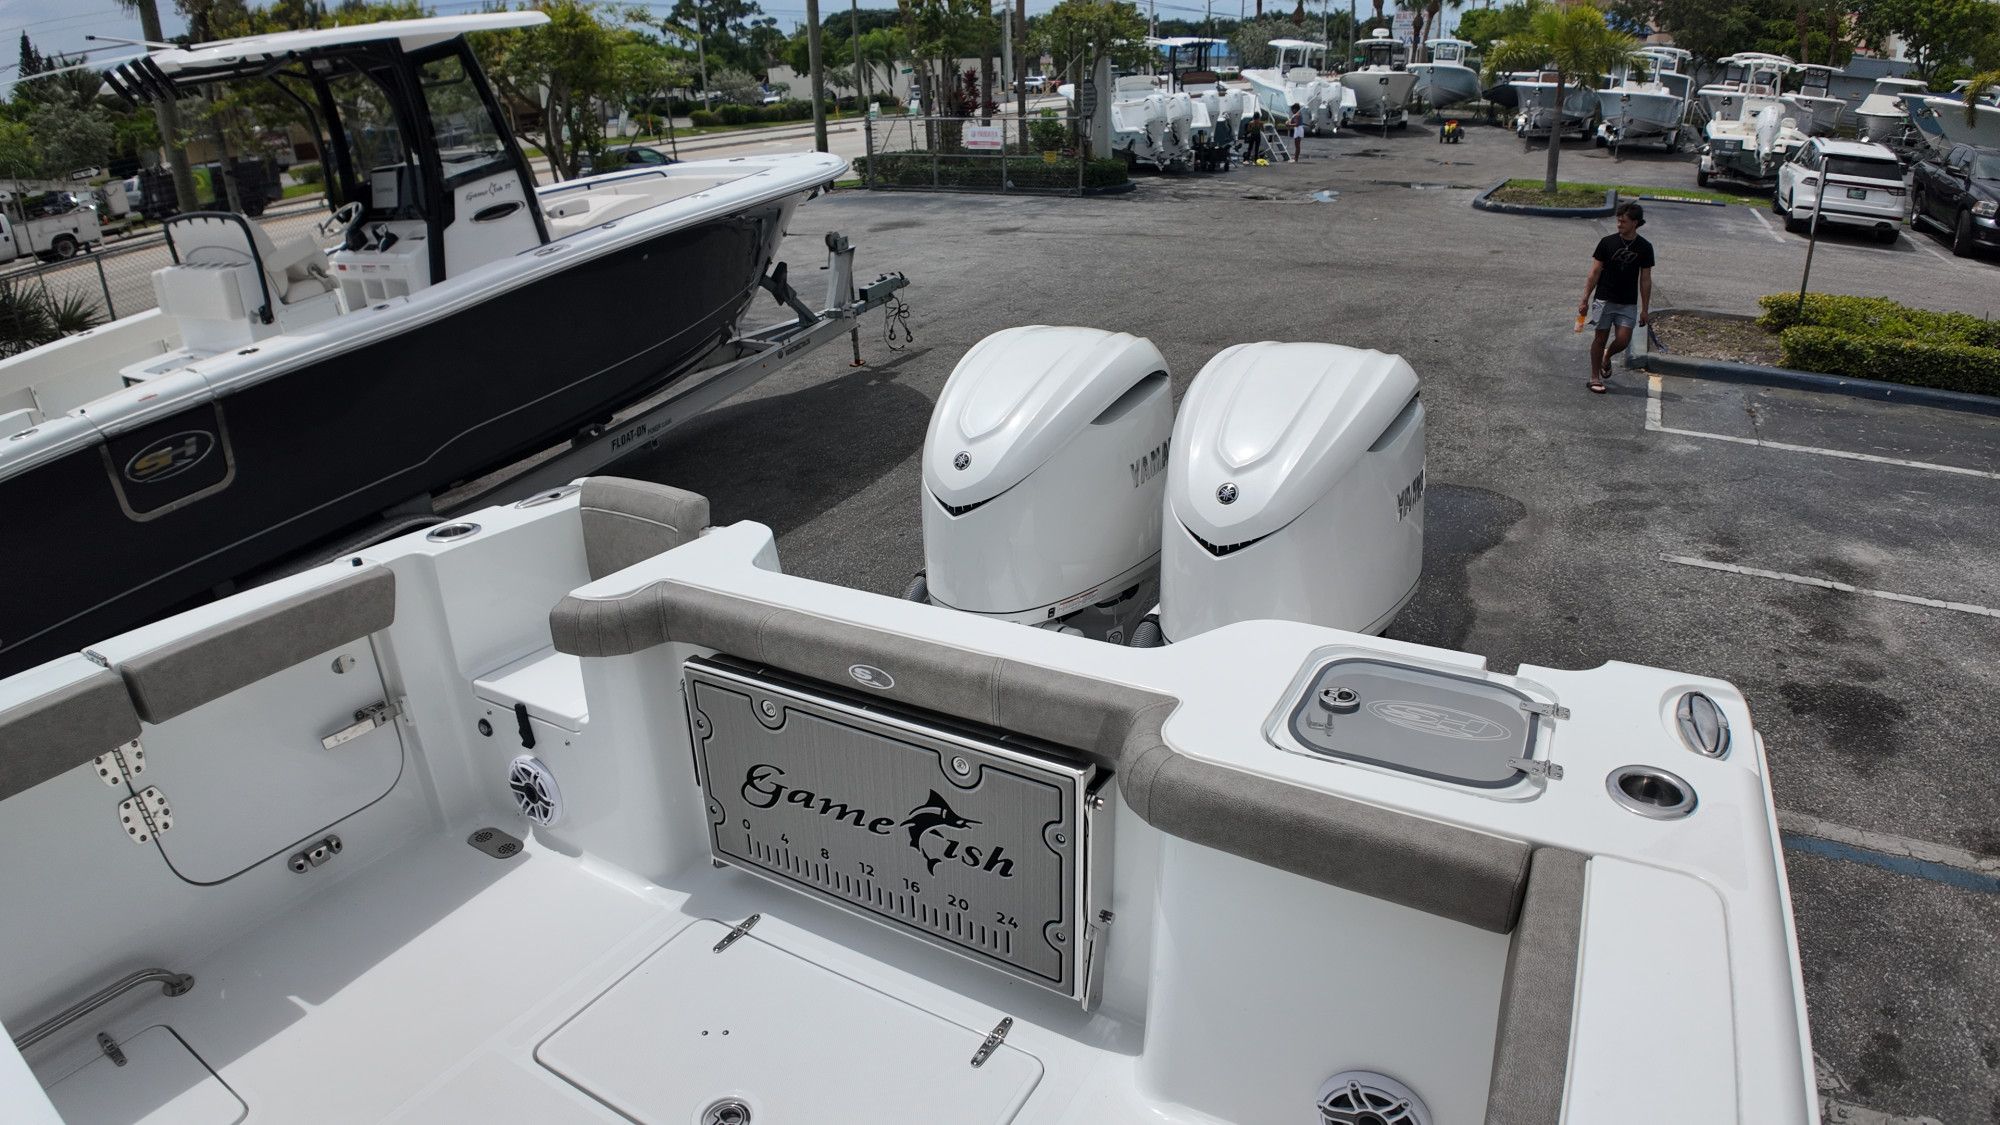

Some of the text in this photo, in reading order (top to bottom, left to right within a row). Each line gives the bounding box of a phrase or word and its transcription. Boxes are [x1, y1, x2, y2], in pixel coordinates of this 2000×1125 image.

[611, 423, 647, 451] FLOAT-ON
[1130, 436, 1171, 488] YAMA
[742, 819, 1019, 929] 0 4 8 12 16 20 24
